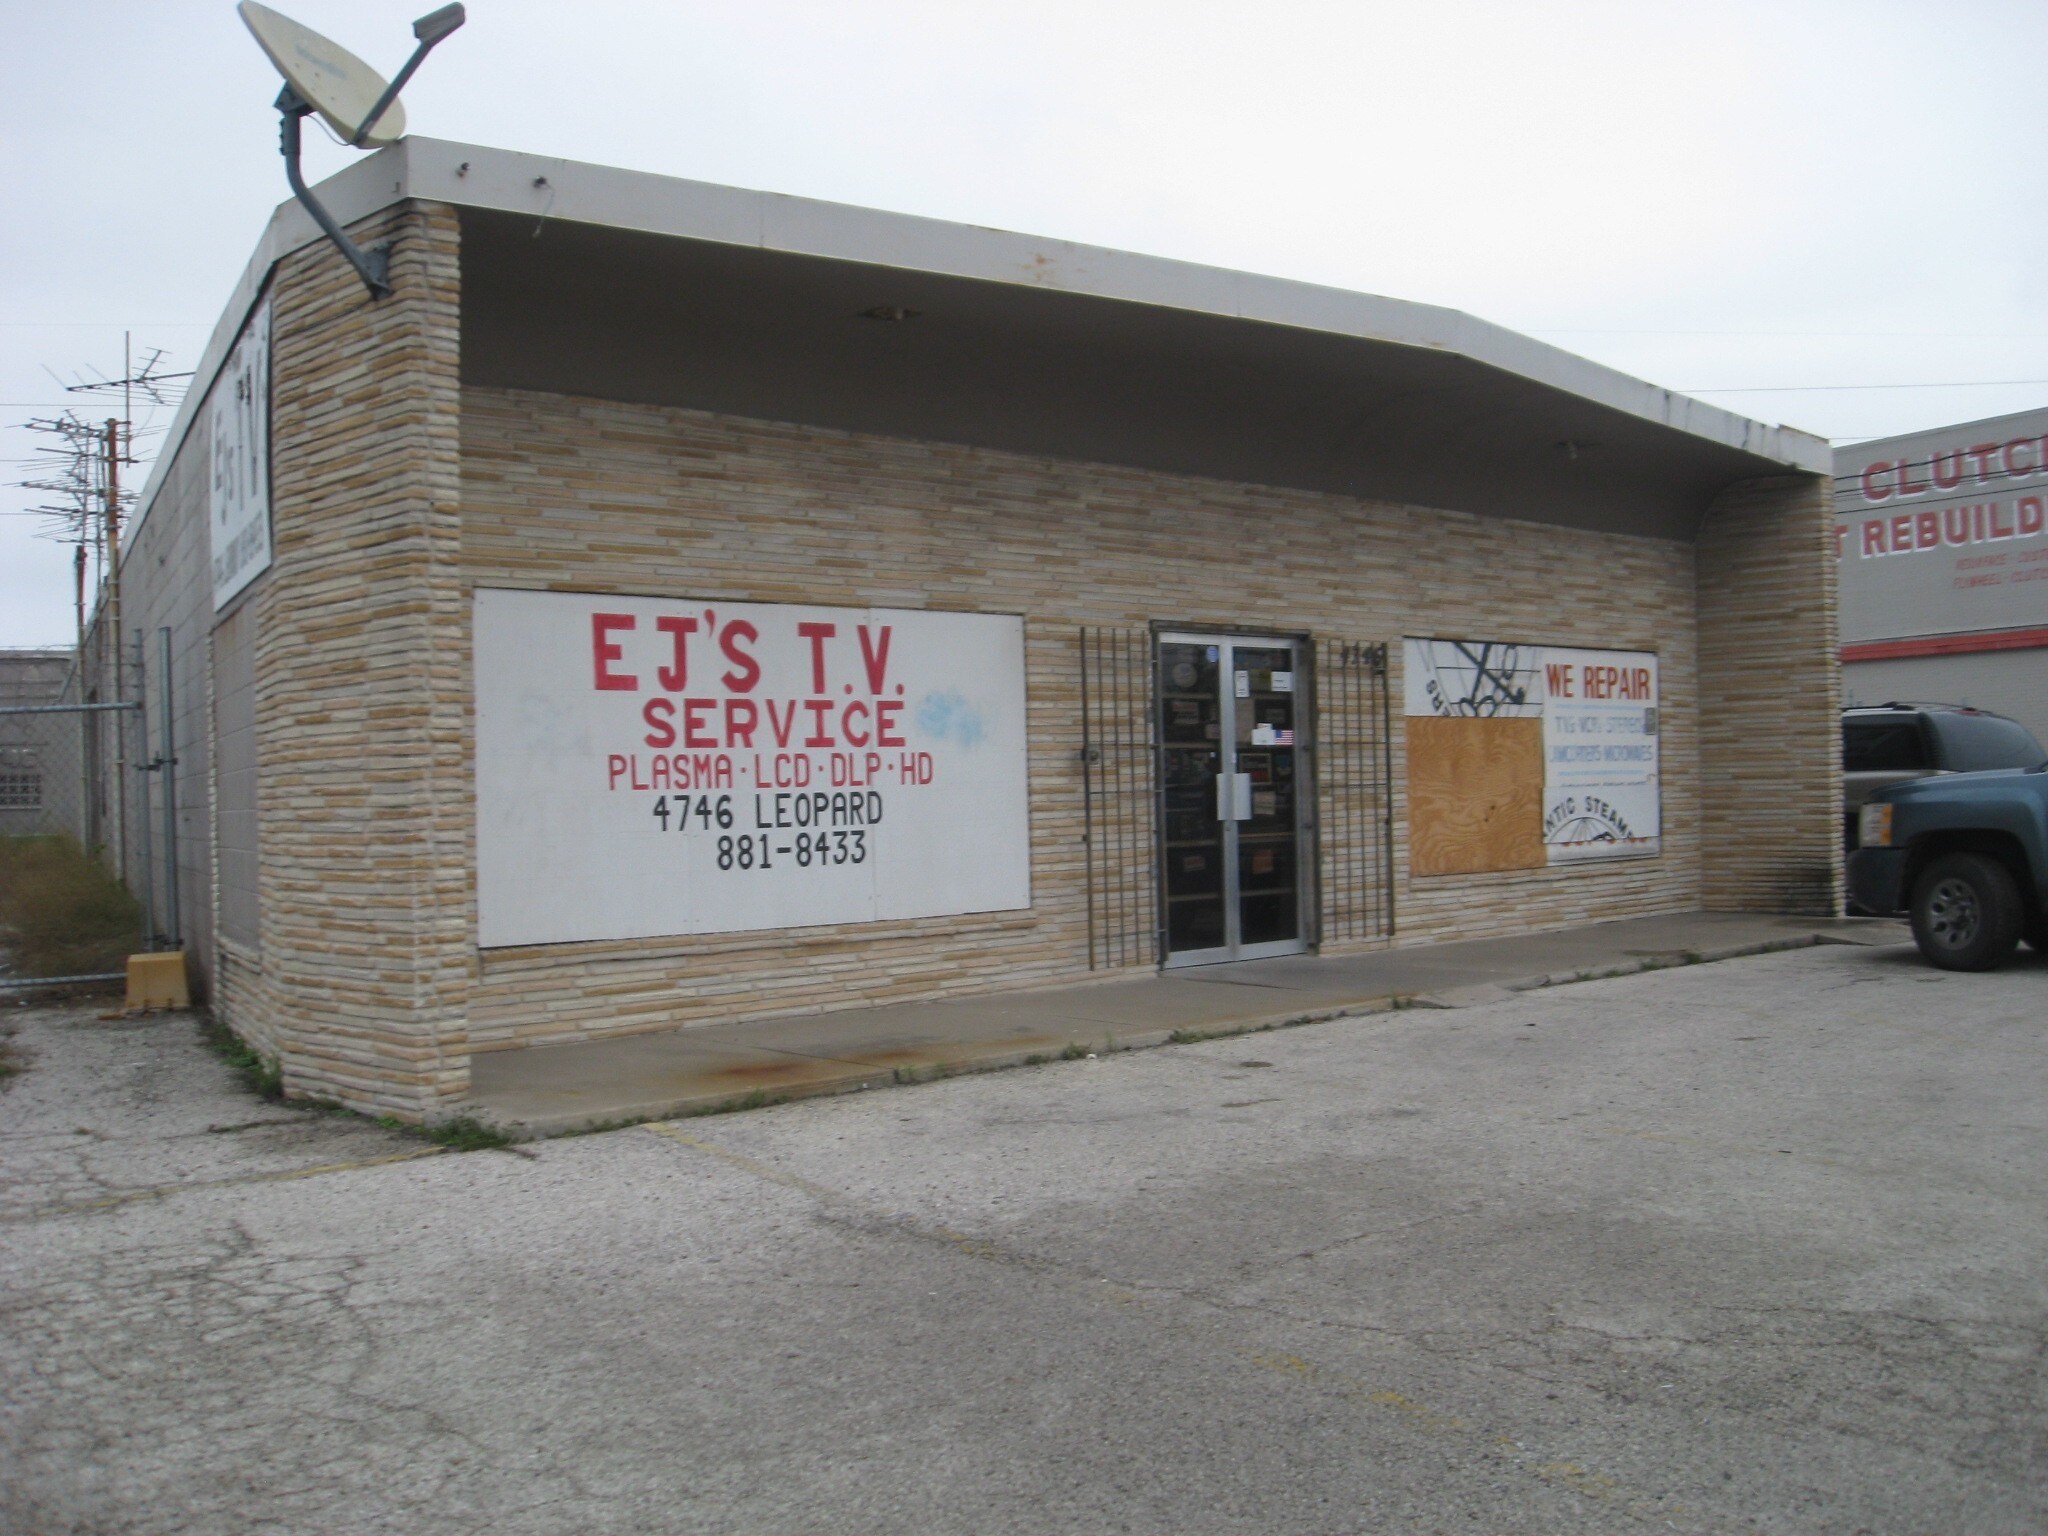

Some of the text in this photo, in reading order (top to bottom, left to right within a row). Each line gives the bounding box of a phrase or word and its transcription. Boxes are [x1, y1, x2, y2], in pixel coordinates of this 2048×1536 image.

[1860, 433, 2048, 502] CLUTC
[1860, 495, 2048, 558] REBUILD
[591, 608, 905, 694] EJ'S T.V.
[1546, 663, 1651, 700] WE REPAIR
[643, 698, 906, 749] SERVICE
[652, 791, 883, 831] 4746 LEOPARD
[716, 830, 867, 870] 881-8433
